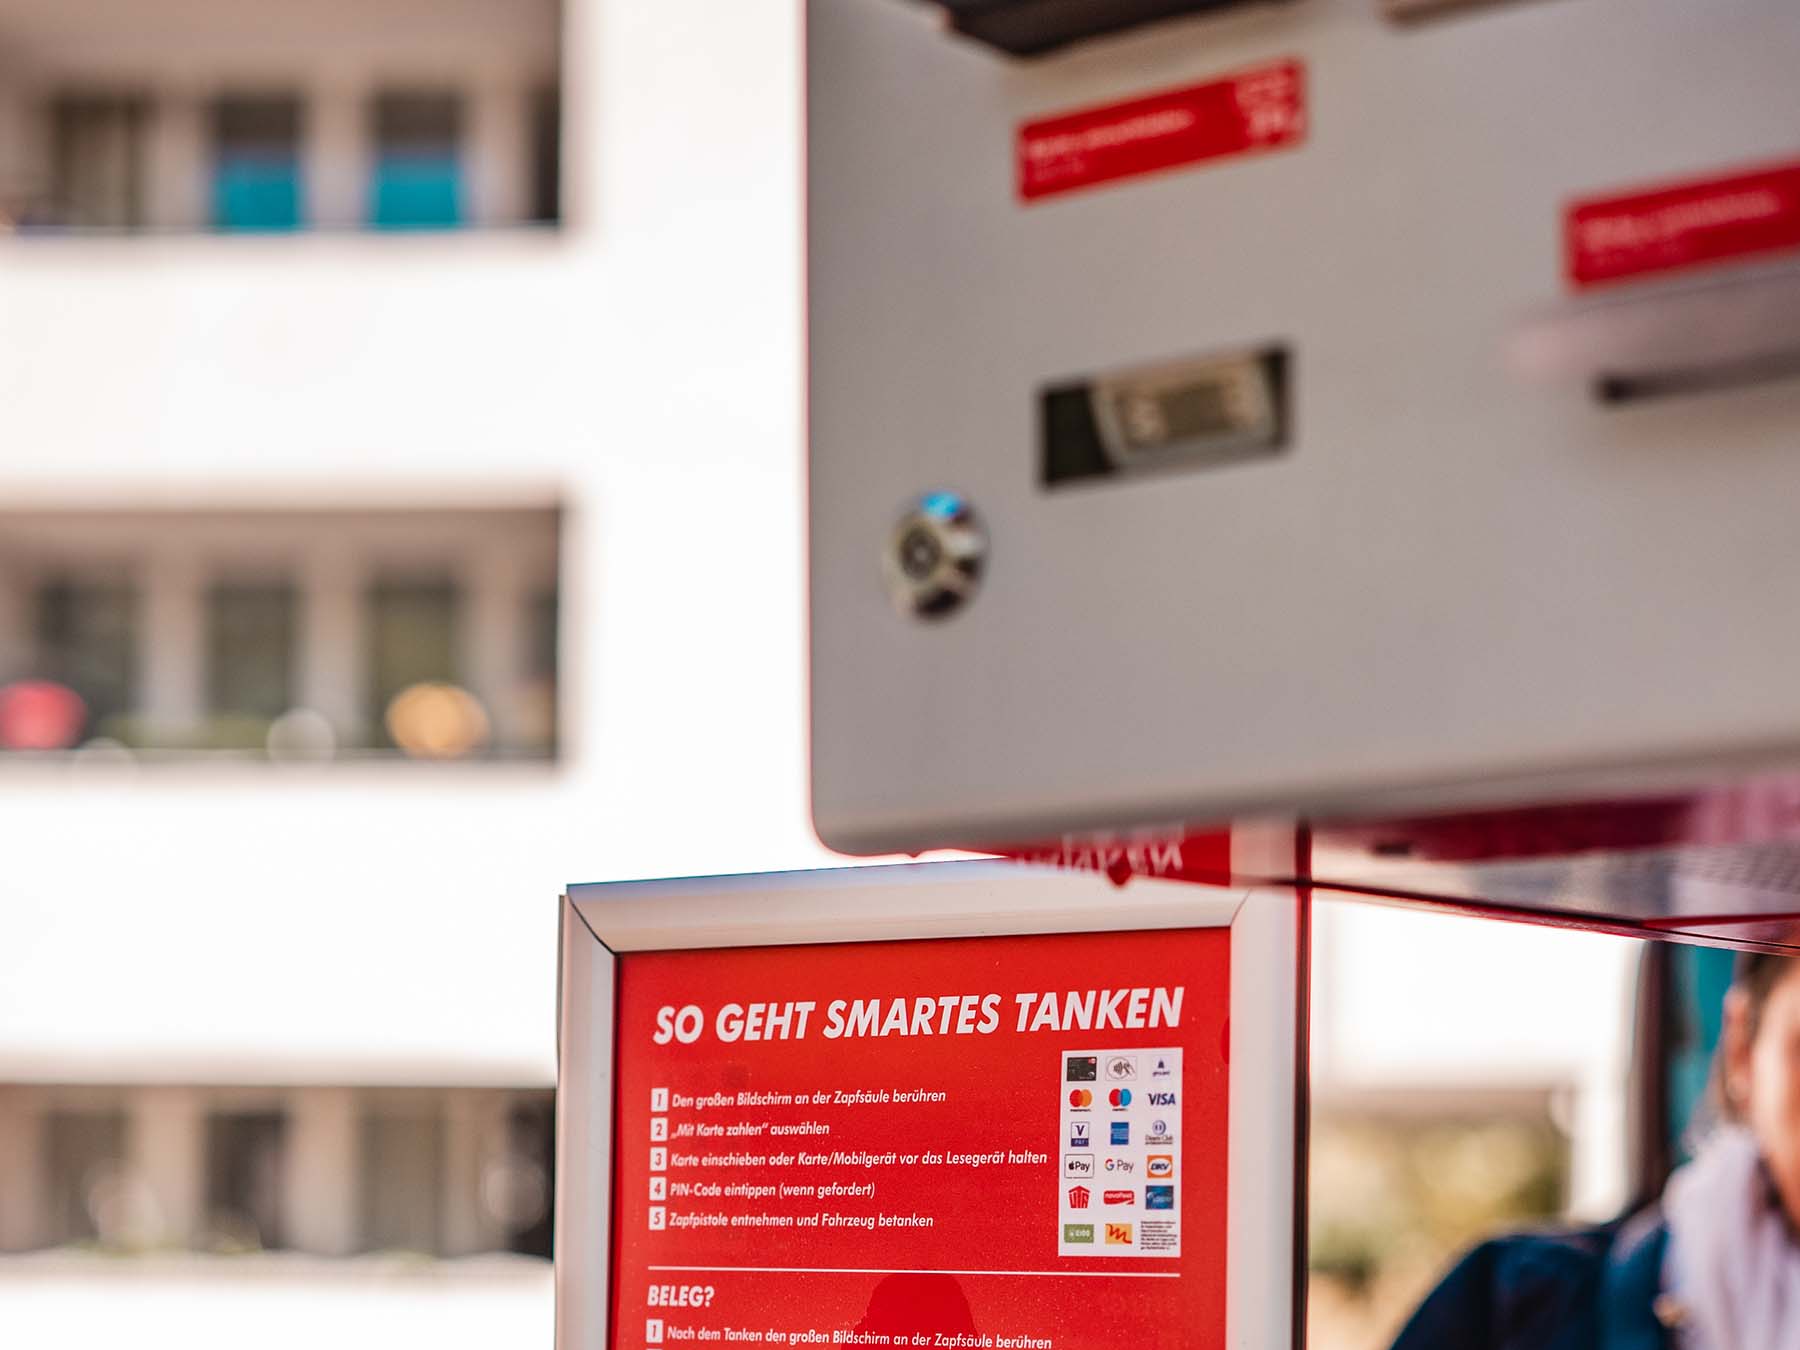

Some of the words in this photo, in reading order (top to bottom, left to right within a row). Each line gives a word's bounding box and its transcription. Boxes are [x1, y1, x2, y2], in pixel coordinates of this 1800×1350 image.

[652, 1004, 705, 1045] SO
[715, 1000, 817, 1043] GEHT
[822, 993, 1002, 1040] SMARTES
[1014, 985, 1185, 1033] TANKEN
[671, 1093, 695, 1108] Den
[695, 1091, 735, 1111] großen
[736, 1090, 793, 1106] Bildschirm
[794, 1094, 810, 1105] an
[811, 1089, 833, 1105] der
[832, 1088, 890, 1108] Zapfsäule
[891, 1087, 947, 1103] berühren
[1148, 1092, 1176, 1106] VISA
[695, 1122, 725, 1137] Karte
[769, 1120, 831, 1136] auswählen
[1076, 1125, 1085, 1136] V
[670, 1153, 700, 1167] Karte
[700, 1151, 767, 1167] einschieben
[768, 1151, 796, 1167] oder
[797, 1150, 898, 1169] Karte/Mobilgerät
[899, 1154, 920, 1165] vor
[921, 1150, 944, 1165] das
[945, 1150, 1006, 1168] Lesegerät
[1007, 1149, 1048, 1165] halten
[1075, 1161, 1091, 1173] Pay
[1105, 1158, 1115, 1171] G
[1117, 1159, 1134, 1173] Pay
[669, 1181, 723, 1197] PIN-Code
[723, 1182, 777, 1200] eintippen
[778, 1182, 815, 1200] (wenn
[816, 1181, 876, 1200] gefordert)
[668, 1211, 729, 1230] Zapfpistole
[730, 1211, 794, 1227] entnehmen
[796, 1212, 820, 1227] und
[821, 1212, 876, 1231] Fahrzeug
[877, 1212, 934, 1228] betanken
[646, 1284, 716, 1308] BELEG?
[666, 1325, 696, 1340] Nach
[696, 1326, 722, 1341] dem
[723, 1326, 763, 1342] Tanken
[764, 1327, 787, 1342] den
[788, 1328, 830, 1346] großen
[832, 1329, 891, 1345] Bildschirm
[892, 1335, 909, 1346] an
[911, 1331, 932, 1347] der
[933, 1332, 993, 1350] Zapfsäule
[995, 1333, 1053, 1350] berühren
